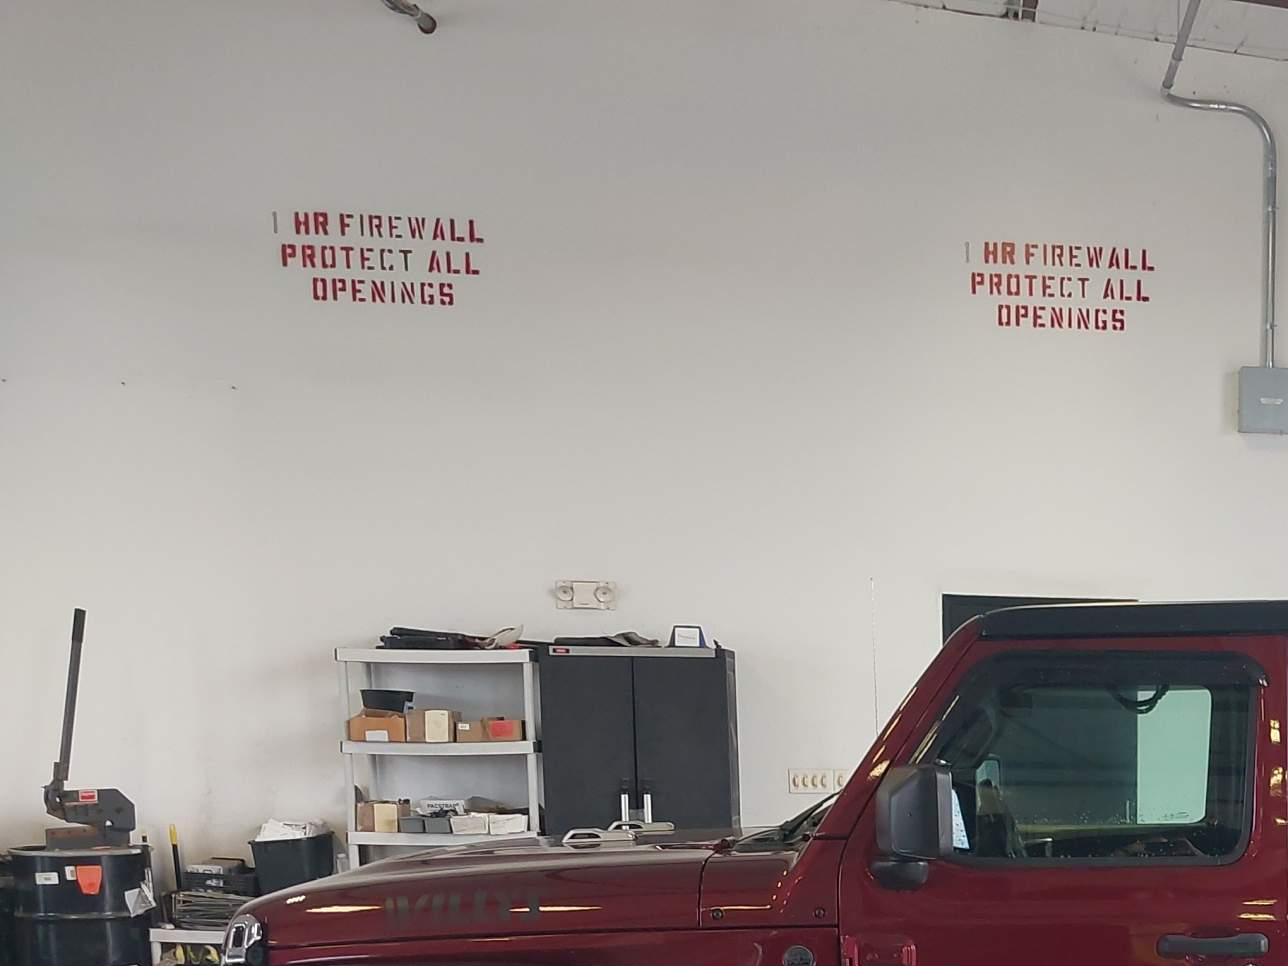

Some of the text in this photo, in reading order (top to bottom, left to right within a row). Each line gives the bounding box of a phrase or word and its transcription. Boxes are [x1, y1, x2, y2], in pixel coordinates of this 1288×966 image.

[293, 211, 330, 236] HR
[338, 213, 485, 243] FIREWALL
[280, 243, 480, 276] PROTECT ALL
[983, 241, 1016, 265] HR
[1024, 243, 1156, 271] FIREWALL
[312, 277, 455, 307] OPENINGS
[970, 271, 1150, 303] PROTECT ALL
[997, 303, 1126, 332] OPENINGS
